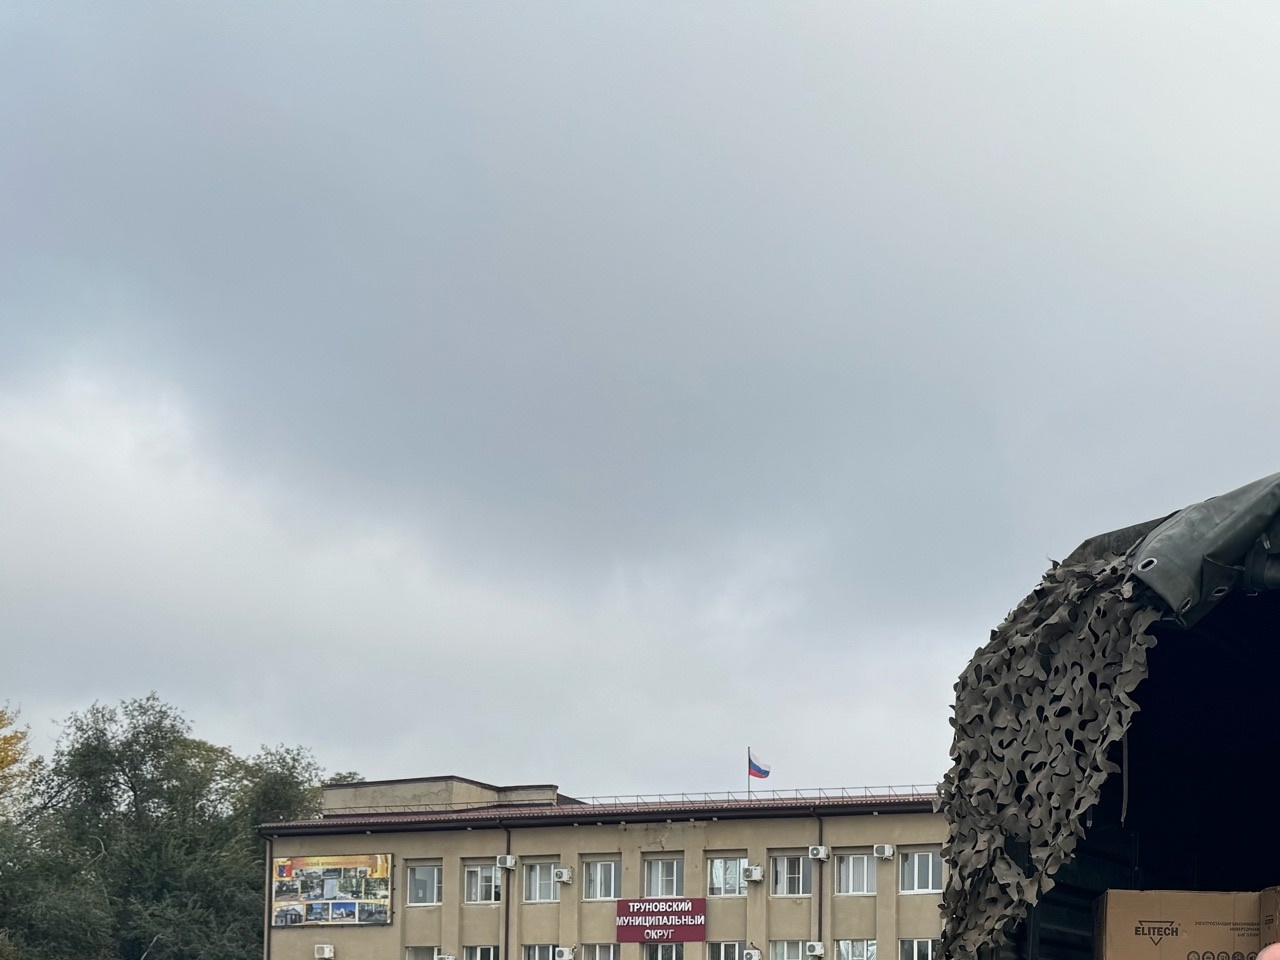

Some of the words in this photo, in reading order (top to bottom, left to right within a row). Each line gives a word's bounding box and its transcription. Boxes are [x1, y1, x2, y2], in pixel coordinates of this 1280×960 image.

[628, 900, 692, 912] ТРУНОВСКИЙ
[616, 914, 705, 927] МУНИЦИПАЛЬНЫЙ
[644, 929, 674, 939] ОКРУГ
[1135, 927, 1179, 936] ELITECH
